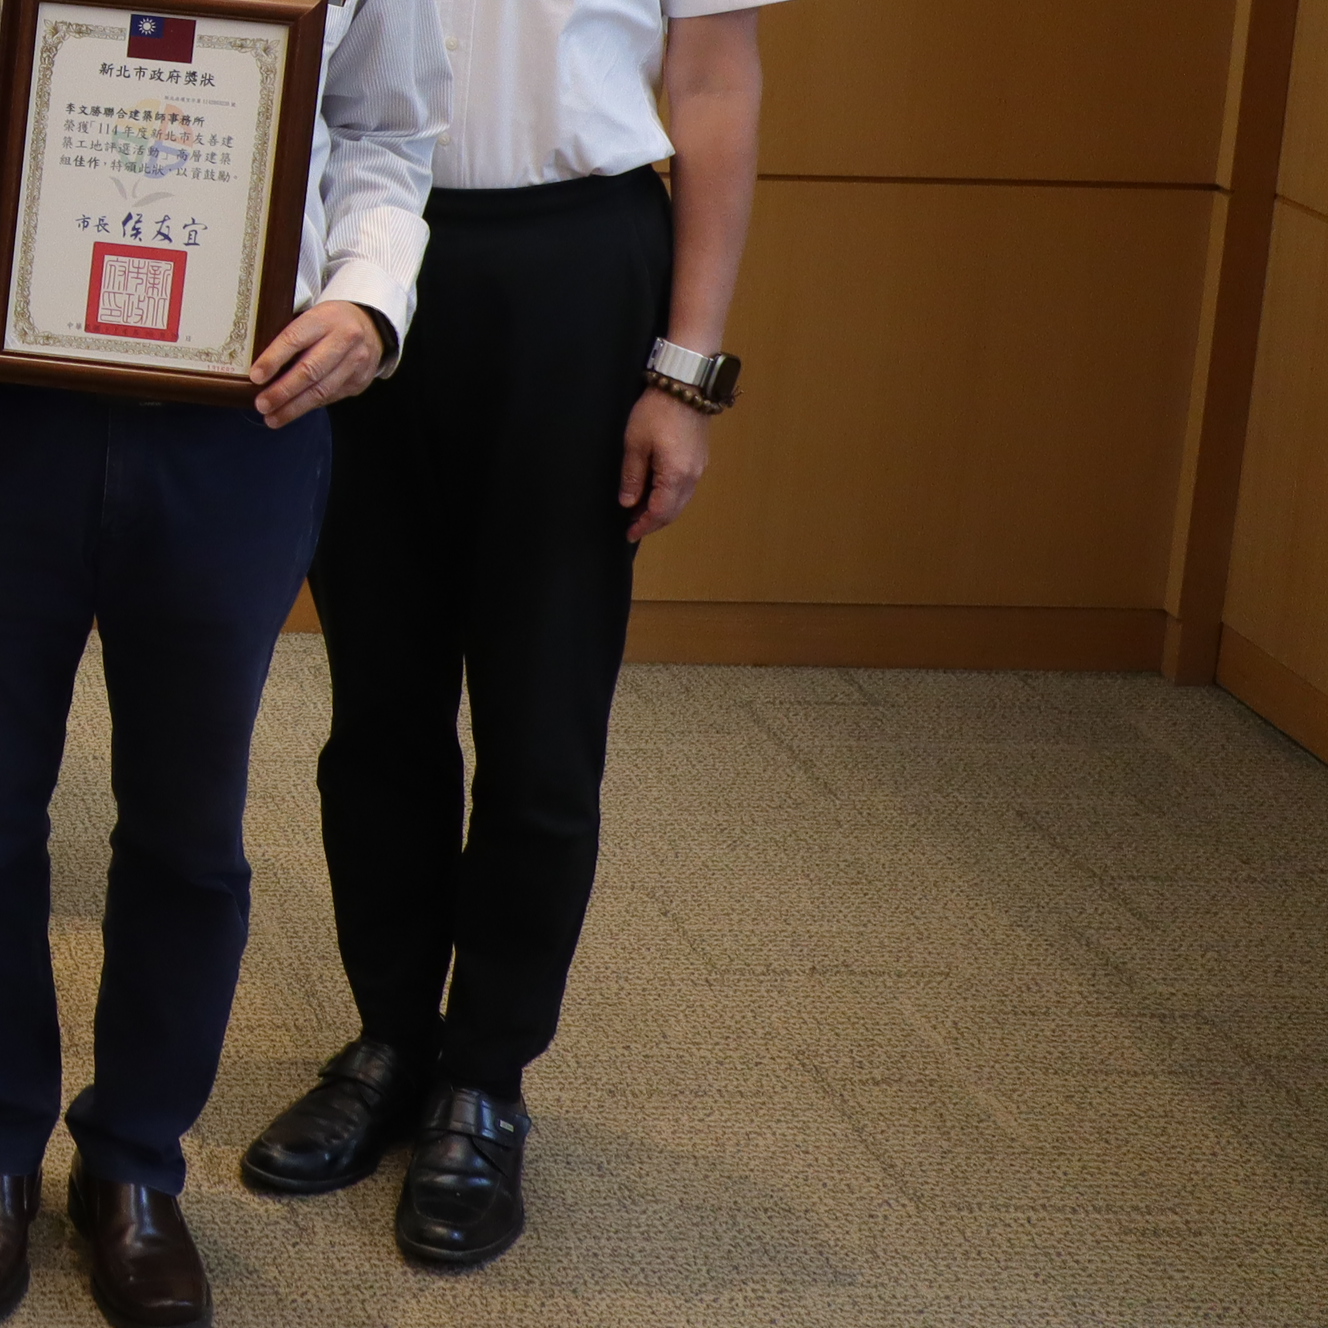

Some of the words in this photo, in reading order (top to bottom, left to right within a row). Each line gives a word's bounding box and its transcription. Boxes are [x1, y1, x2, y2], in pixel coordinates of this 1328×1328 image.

[98, 61, 216, 88] 新北市政府獎狀
[64, 102, 206, 127] 李文勝聯合建築師事務所
[75, 214, 111, 234] 市長
[121, 211, 208, 247] 侯友宜
